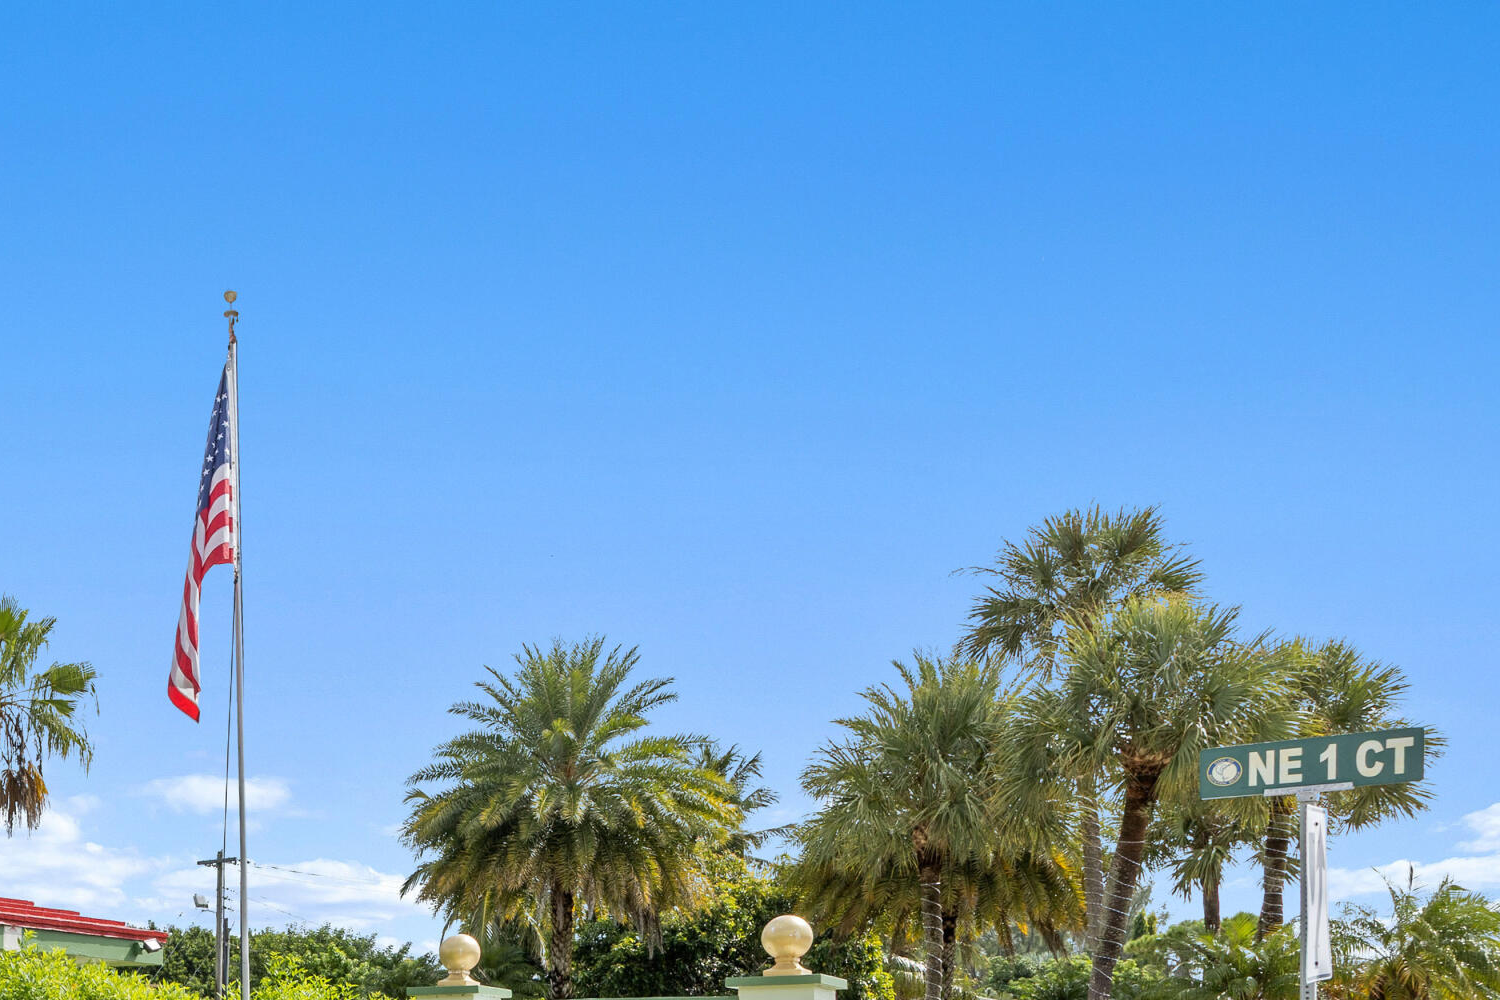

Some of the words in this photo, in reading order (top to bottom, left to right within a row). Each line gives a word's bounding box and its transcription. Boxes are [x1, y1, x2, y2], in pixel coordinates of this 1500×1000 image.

[1248, 747, 1303, 787] NE
[1319, 743, 1337, 780] 1
[1355, 736, 1415, 778] CT
